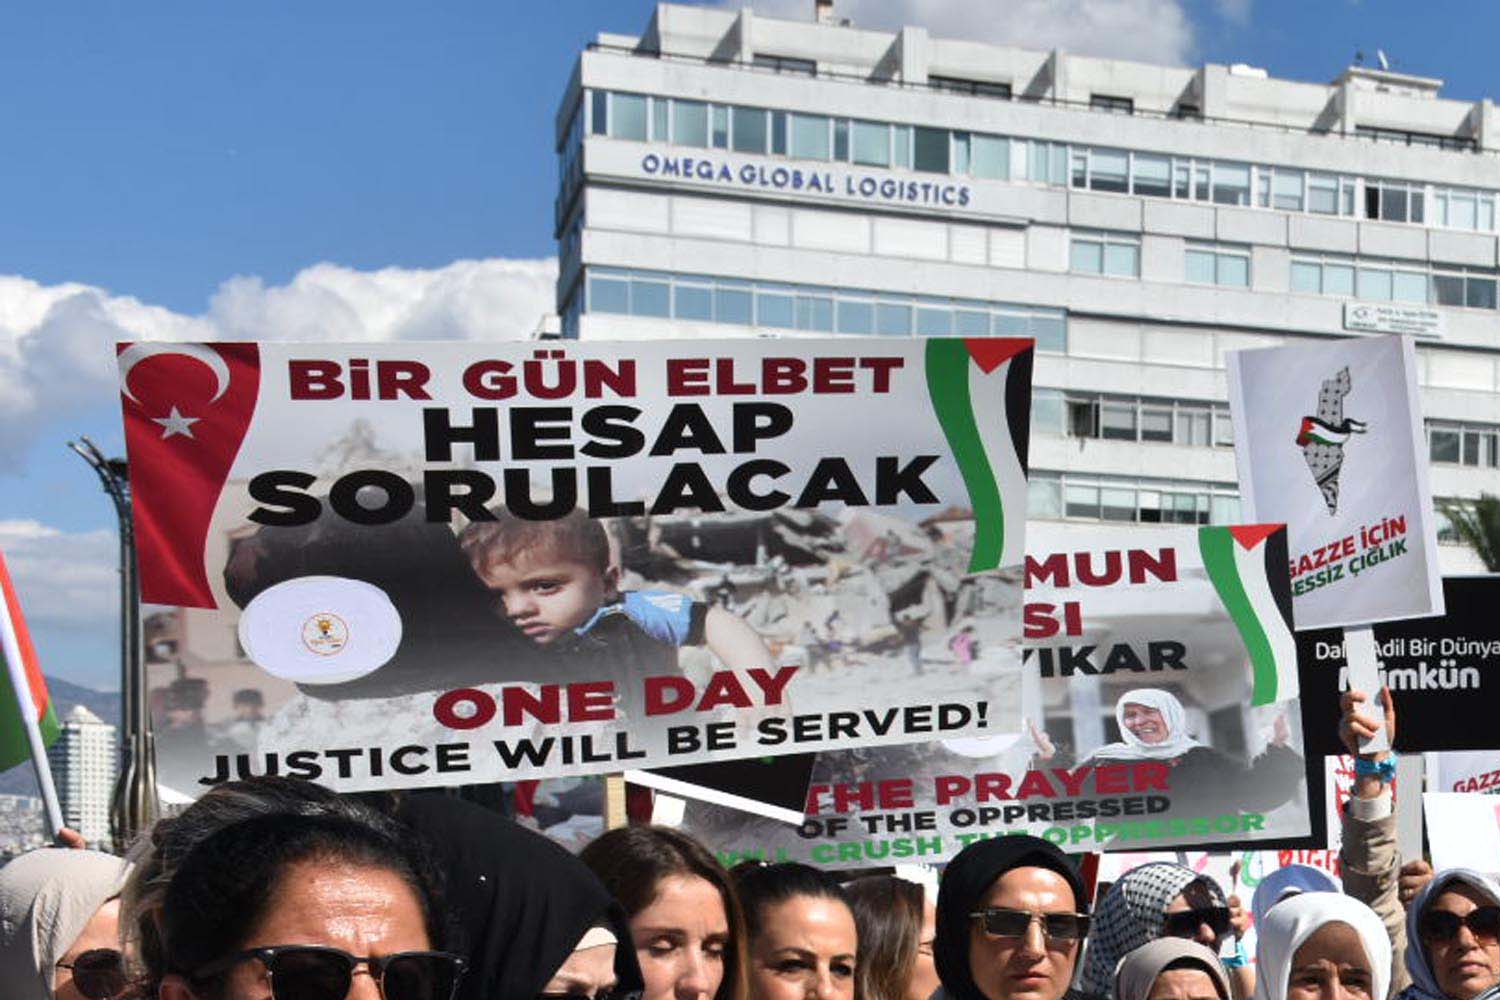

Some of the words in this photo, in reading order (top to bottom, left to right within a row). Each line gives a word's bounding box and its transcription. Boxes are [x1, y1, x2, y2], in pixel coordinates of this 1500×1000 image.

[642, 154, 733, 182] OMEGA
[740, 164, 834, 194] GLOBAL
[847, 176, 970, 206] LOGISTICS
[462, 350, 636, 400] GÜN
[666, 357, 904, 396] ELBET
[423, 402, 794, 462] HESAP
[247, 455, 941, 527] SORULACAK
[1360, 514, 1407, 549] İÇİN
[1023, 547, 1178, 589] MUN
[1291, 563, 1344, 597] ESSİZ
[1348, 538, 1408, 577] ÇIĞLIK
[1023, 601, 1083, 639] SI
[1022, 640, 1188, 678] IKAR
[1409, 638, 1435, 656] Bir
[433, 681, 616, 730] ONE
[644, 666, 800, 716] DAY
[198, 742, 472, 785] JUSTICE
[493, 731, 646, 769] WILL
[668, 721, 737, 755] BE
[757, 701, 989, 746] SERVED!
[804, 778, 914, 816] THE
[935, 760, 1171, 806] PRAYER
[796, 816, 849, 839] OF
[860, 811, 937, 834] THE
[949, 795, 1171, 828] OPPRESSED
[811, 835, 942, 864] CRUSH
